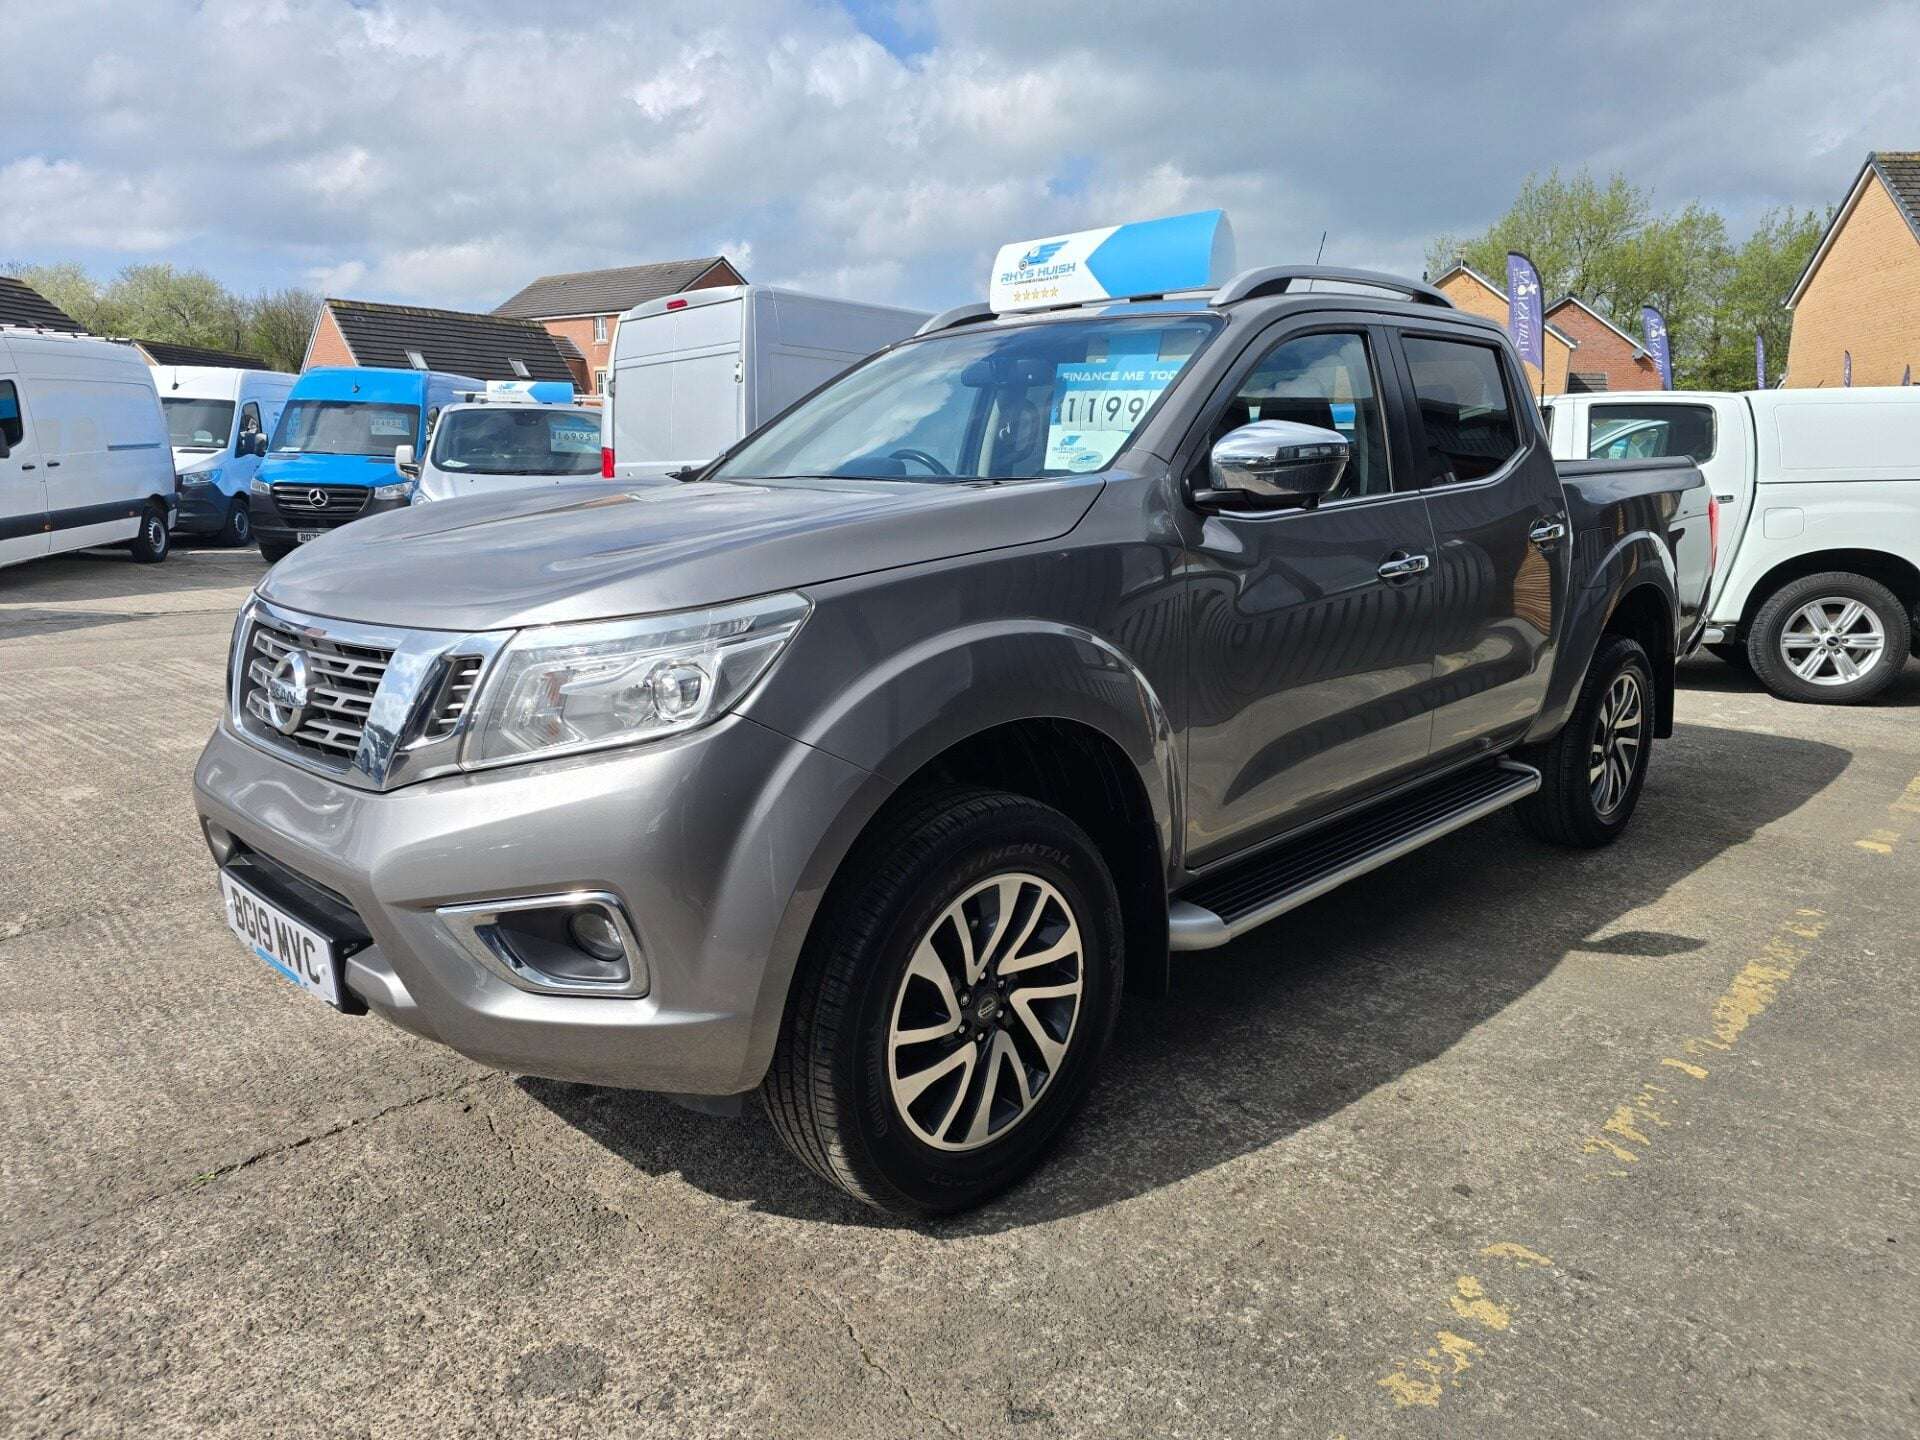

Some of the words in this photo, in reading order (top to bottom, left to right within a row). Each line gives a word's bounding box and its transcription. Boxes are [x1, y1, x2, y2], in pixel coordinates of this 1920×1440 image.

[1001, 269, 1034, 283] RHYS
[1037, 262, 1077, 277] HUISH
[1062, 371, 1118, 382] FINANCE
[1121, 371, 1145, 381] ME
[231, 885, 273, 953] BG19
[273, 916, 321, 985] MVC
